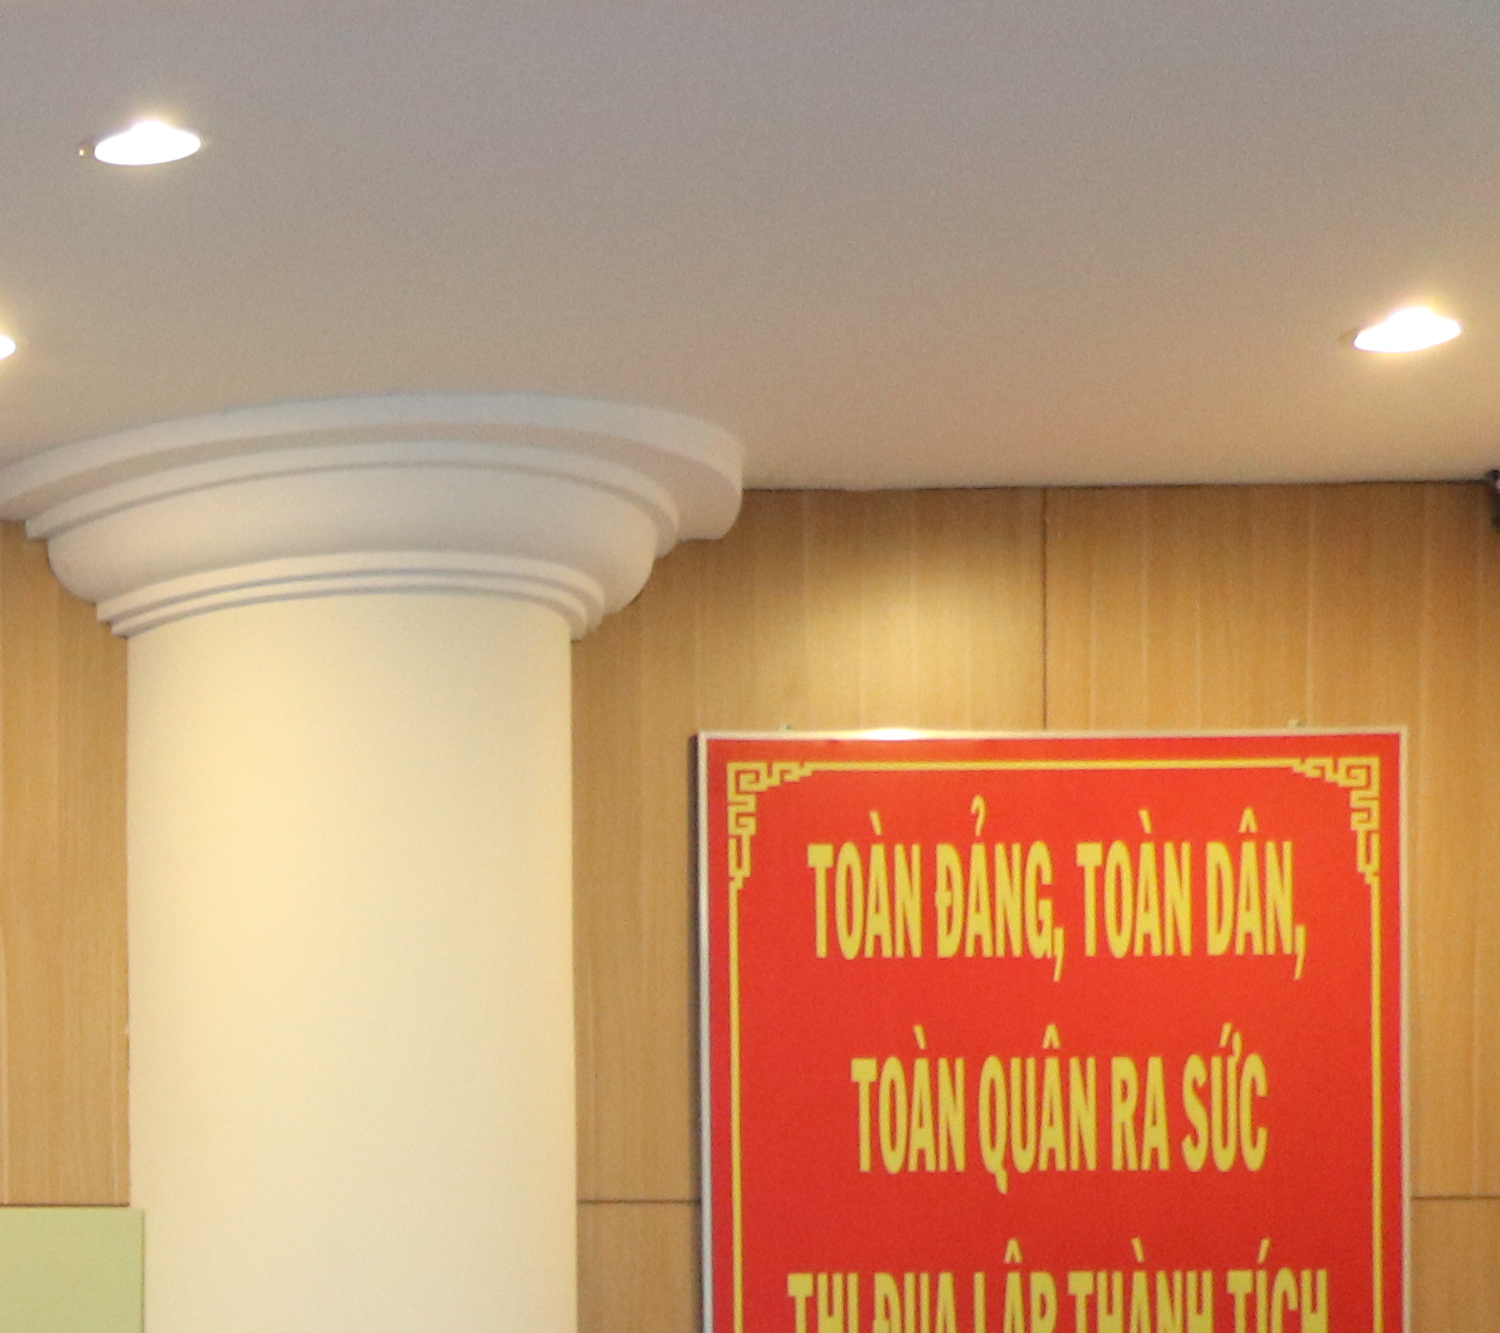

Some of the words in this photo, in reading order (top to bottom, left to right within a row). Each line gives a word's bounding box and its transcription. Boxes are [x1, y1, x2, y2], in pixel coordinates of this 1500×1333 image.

[807, 811, 922, 959] TOÀN
[935, 796, 1064, 980] ĐẢNG,
[1076, 810, 1191, 958] TOÀN
[1206, 808, 1307, 978] DÂN,
[851, 1025, 965, 1174] TOÀN
[979, 1024, 1097, 1193] QUÂN
[1112, 1056, 1169, 1172] RA
[1183, 1023, 1268, 1172] SỨC
